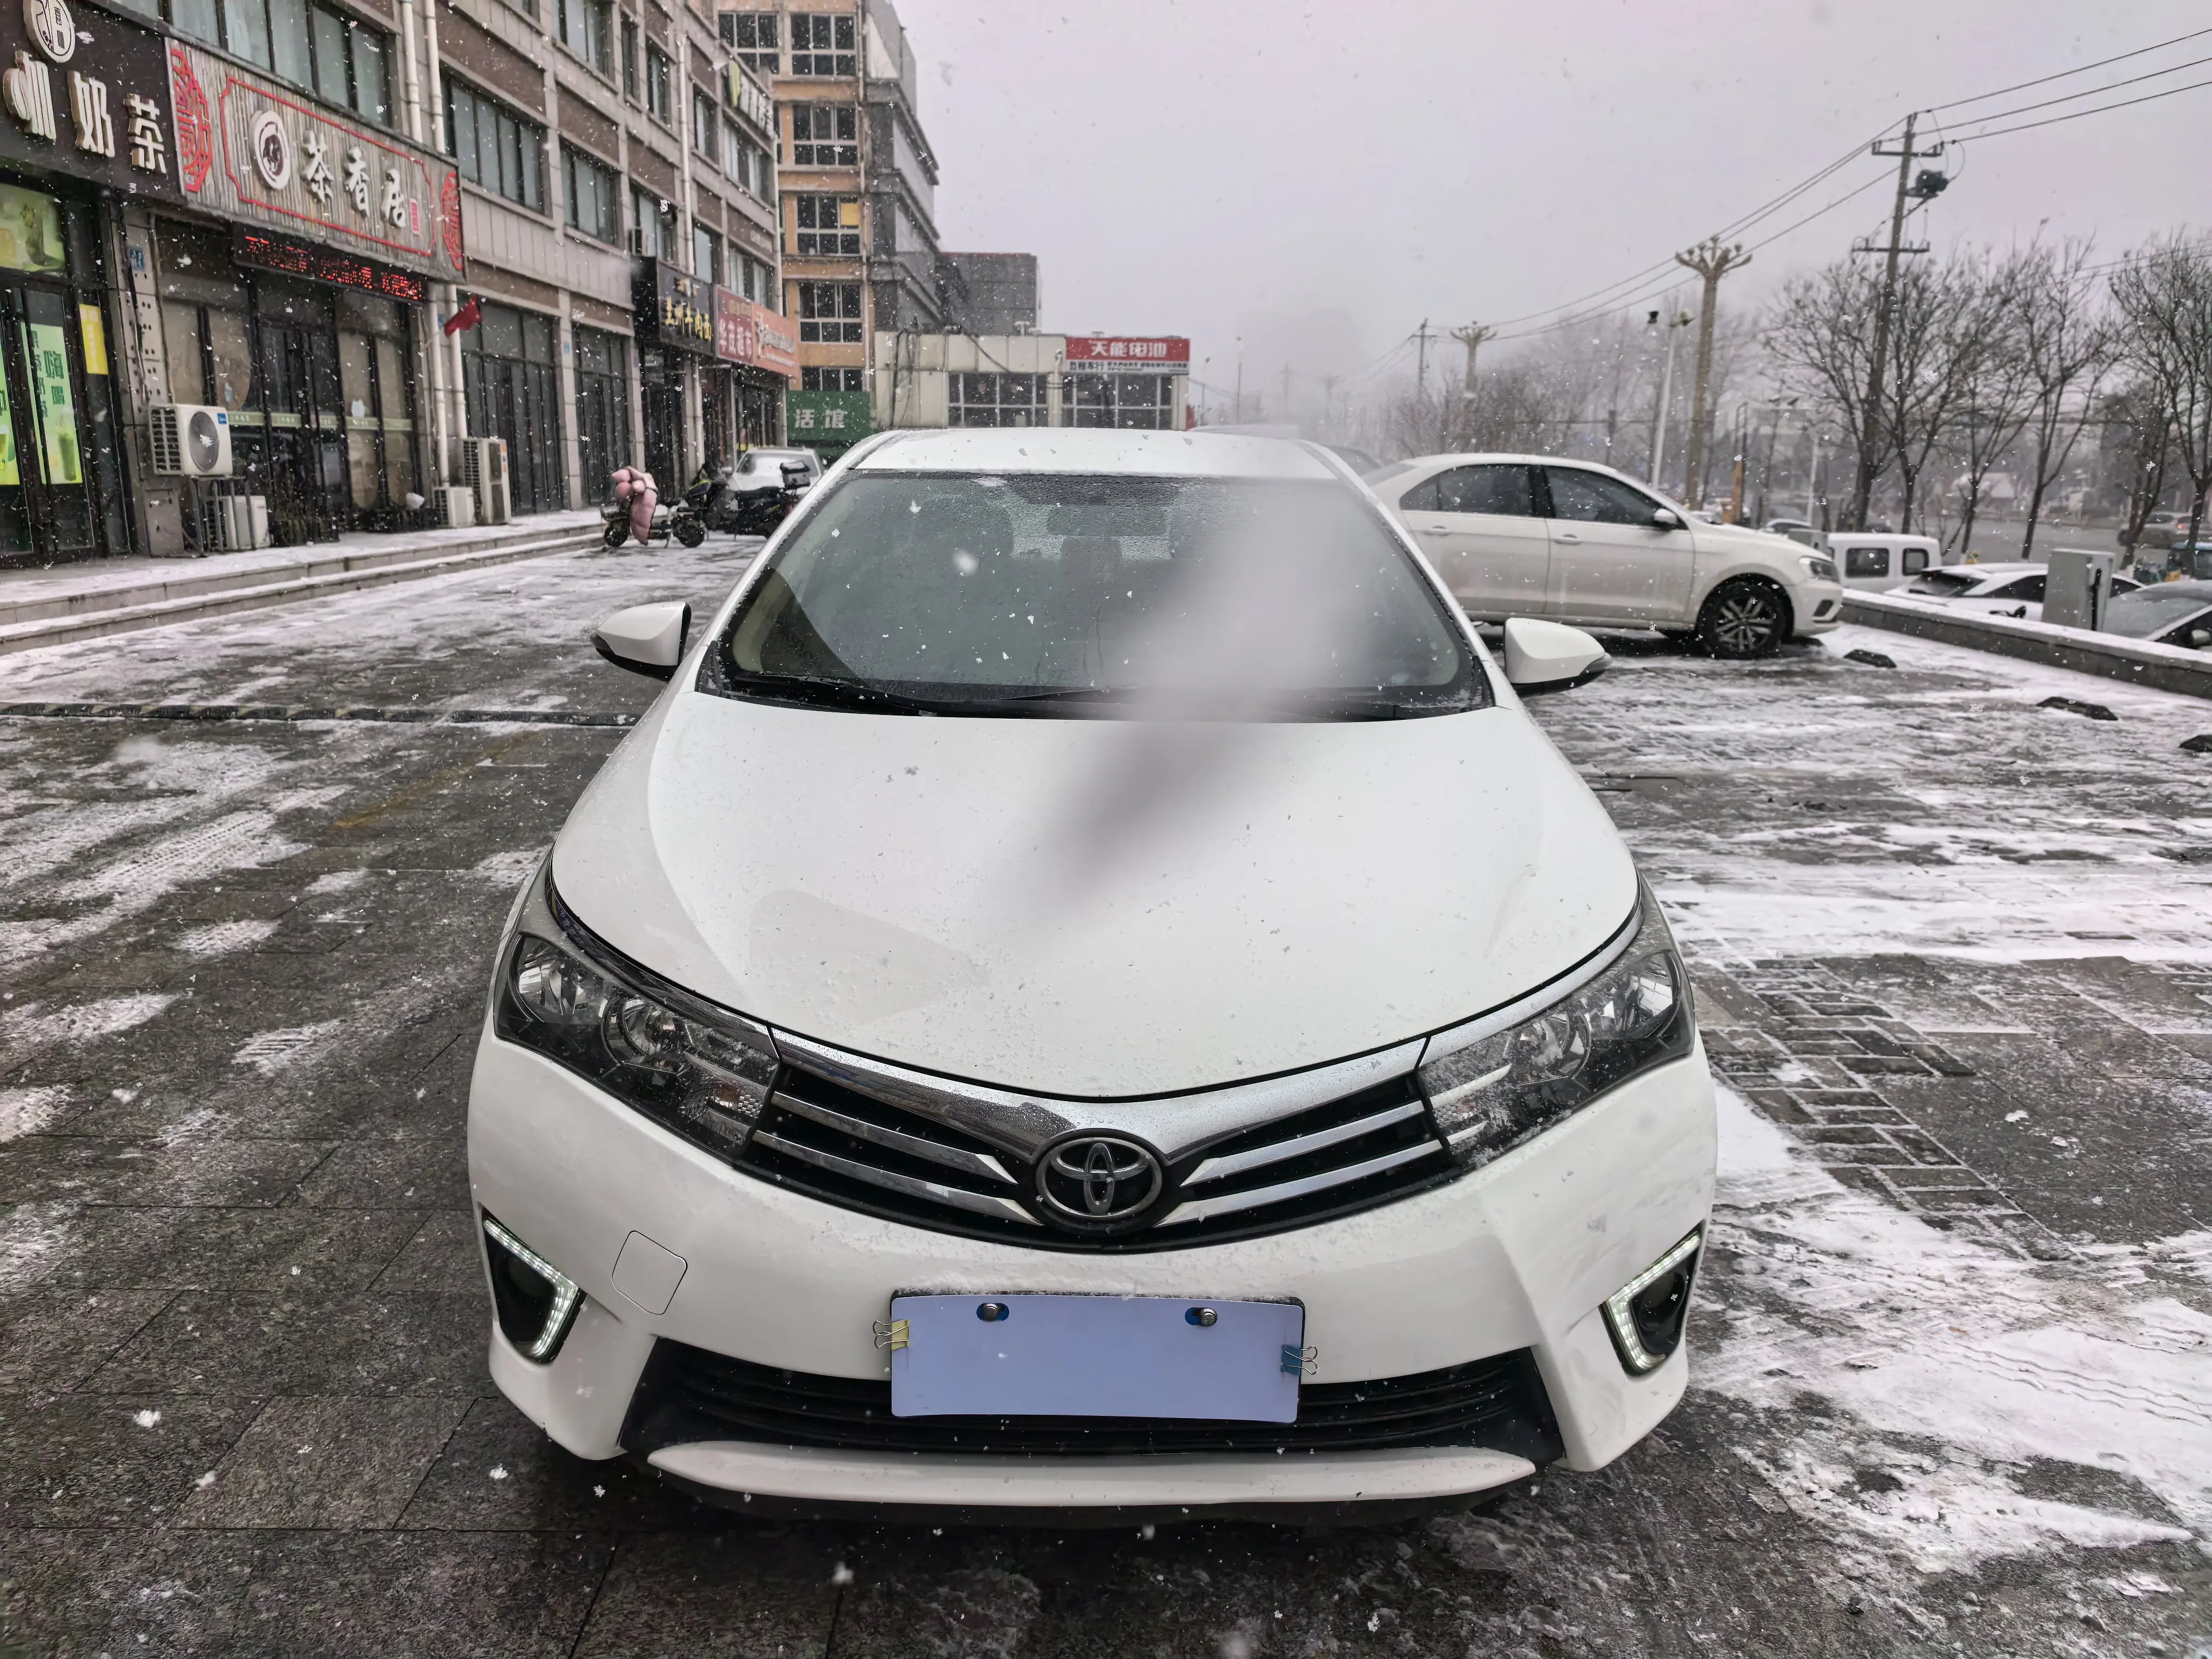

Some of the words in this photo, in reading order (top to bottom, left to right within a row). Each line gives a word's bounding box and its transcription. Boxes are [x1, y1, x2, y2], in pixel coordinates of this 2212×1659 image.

[301, 130, 406, 229] 茶香居
[1090, 341, 1168, 358] 天能电池
[795, 409, 846, 429] 活馆
